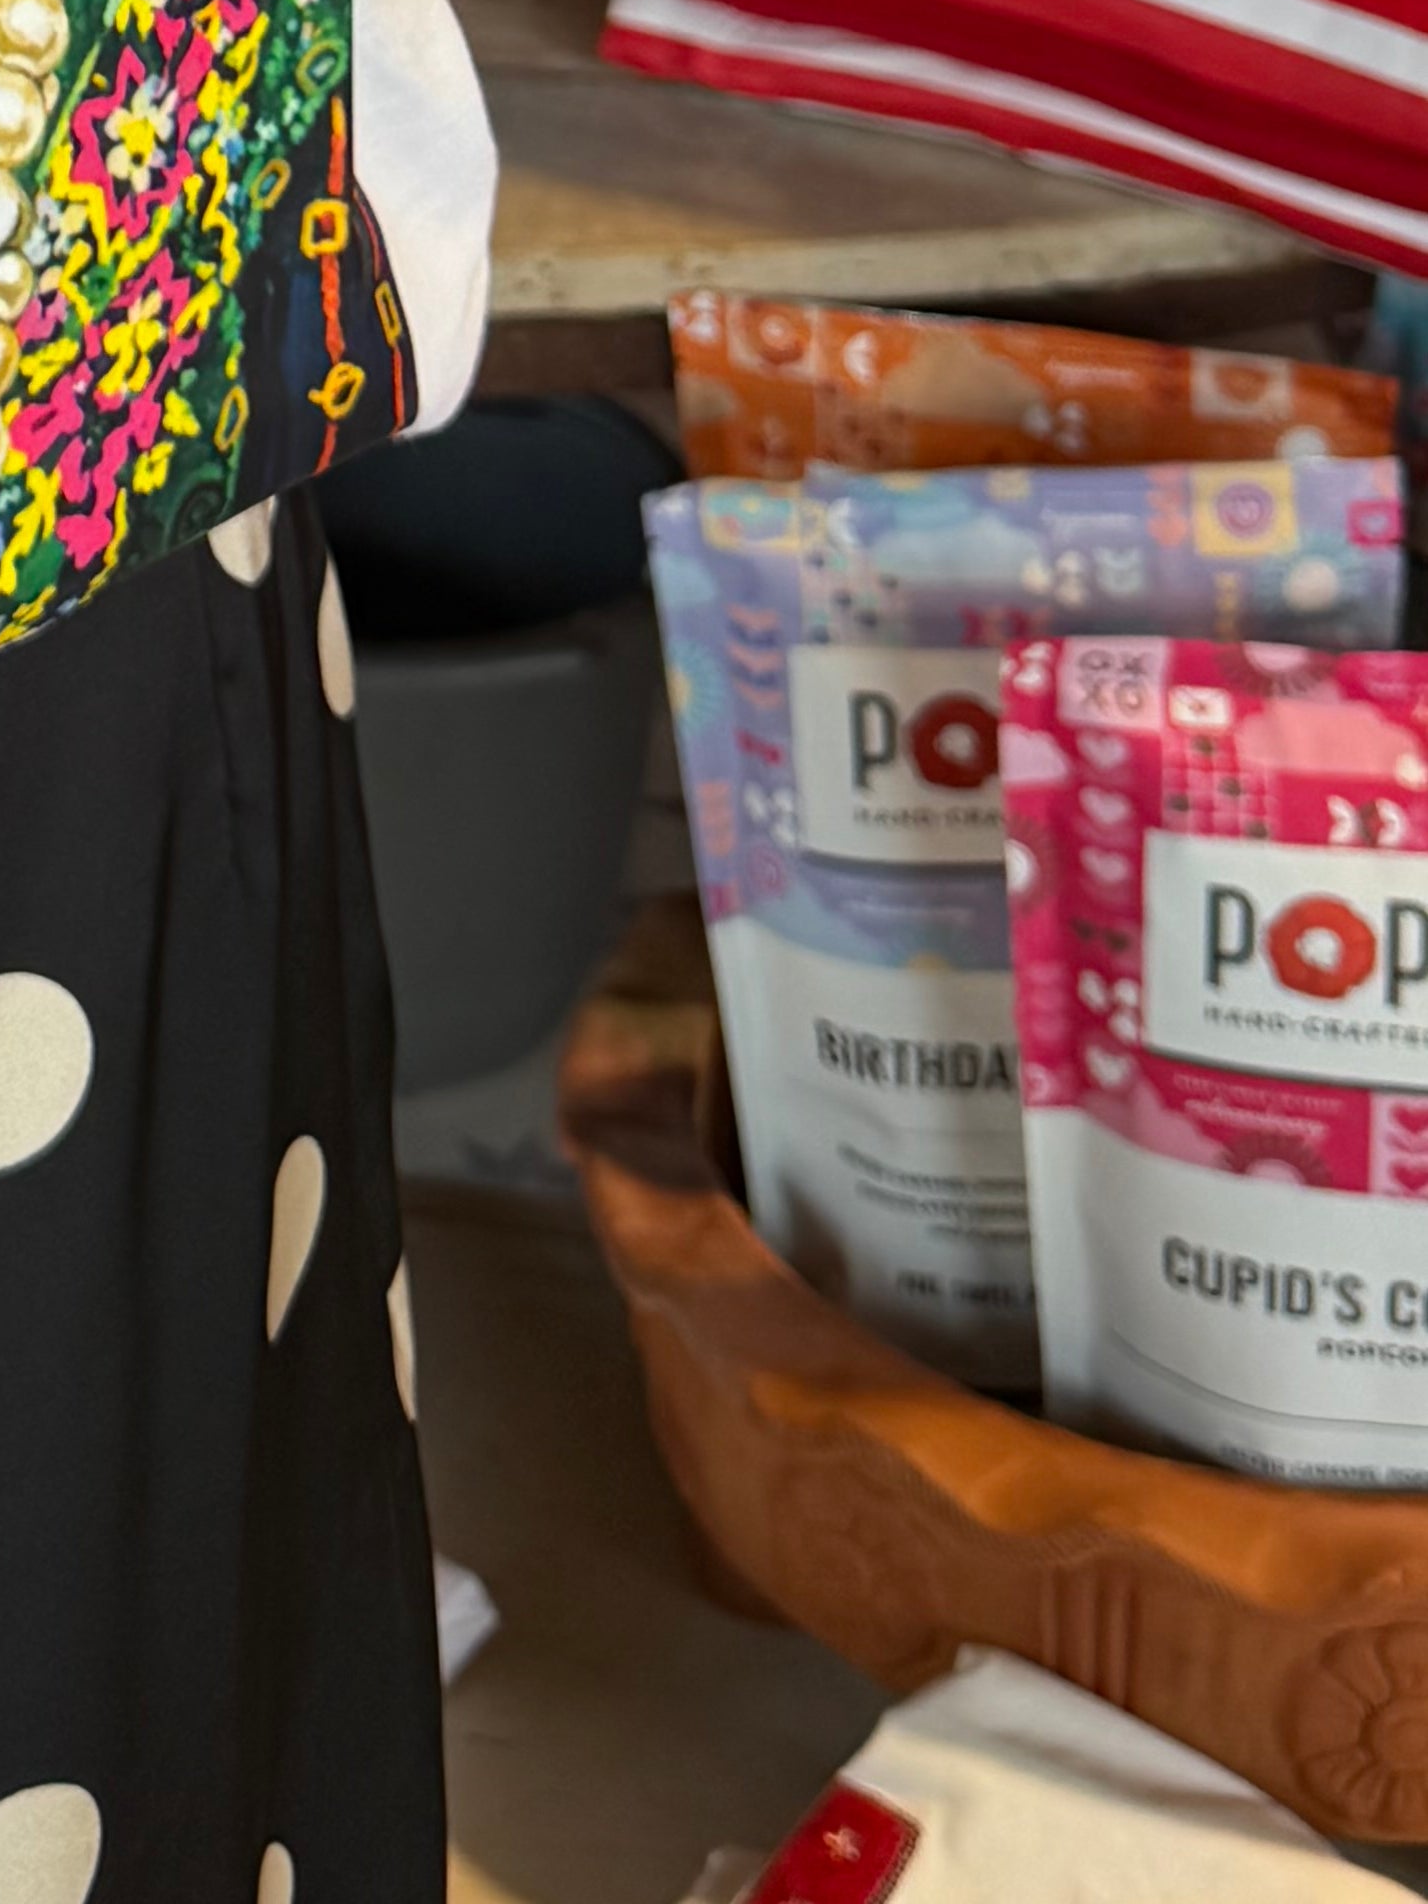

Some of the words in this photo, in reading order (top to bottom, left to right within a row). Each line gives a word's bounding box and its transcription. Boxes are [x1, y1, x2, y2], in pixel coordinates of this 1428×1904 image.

[814, 1015, 1020, 1090] BIRTHDA
[1204, 1004, 1428, 1046] HAND-CRAFTE
[1160, 1235, 1365, 1325] CUPID'S
[1385, 1279, 1428, 1333] C
